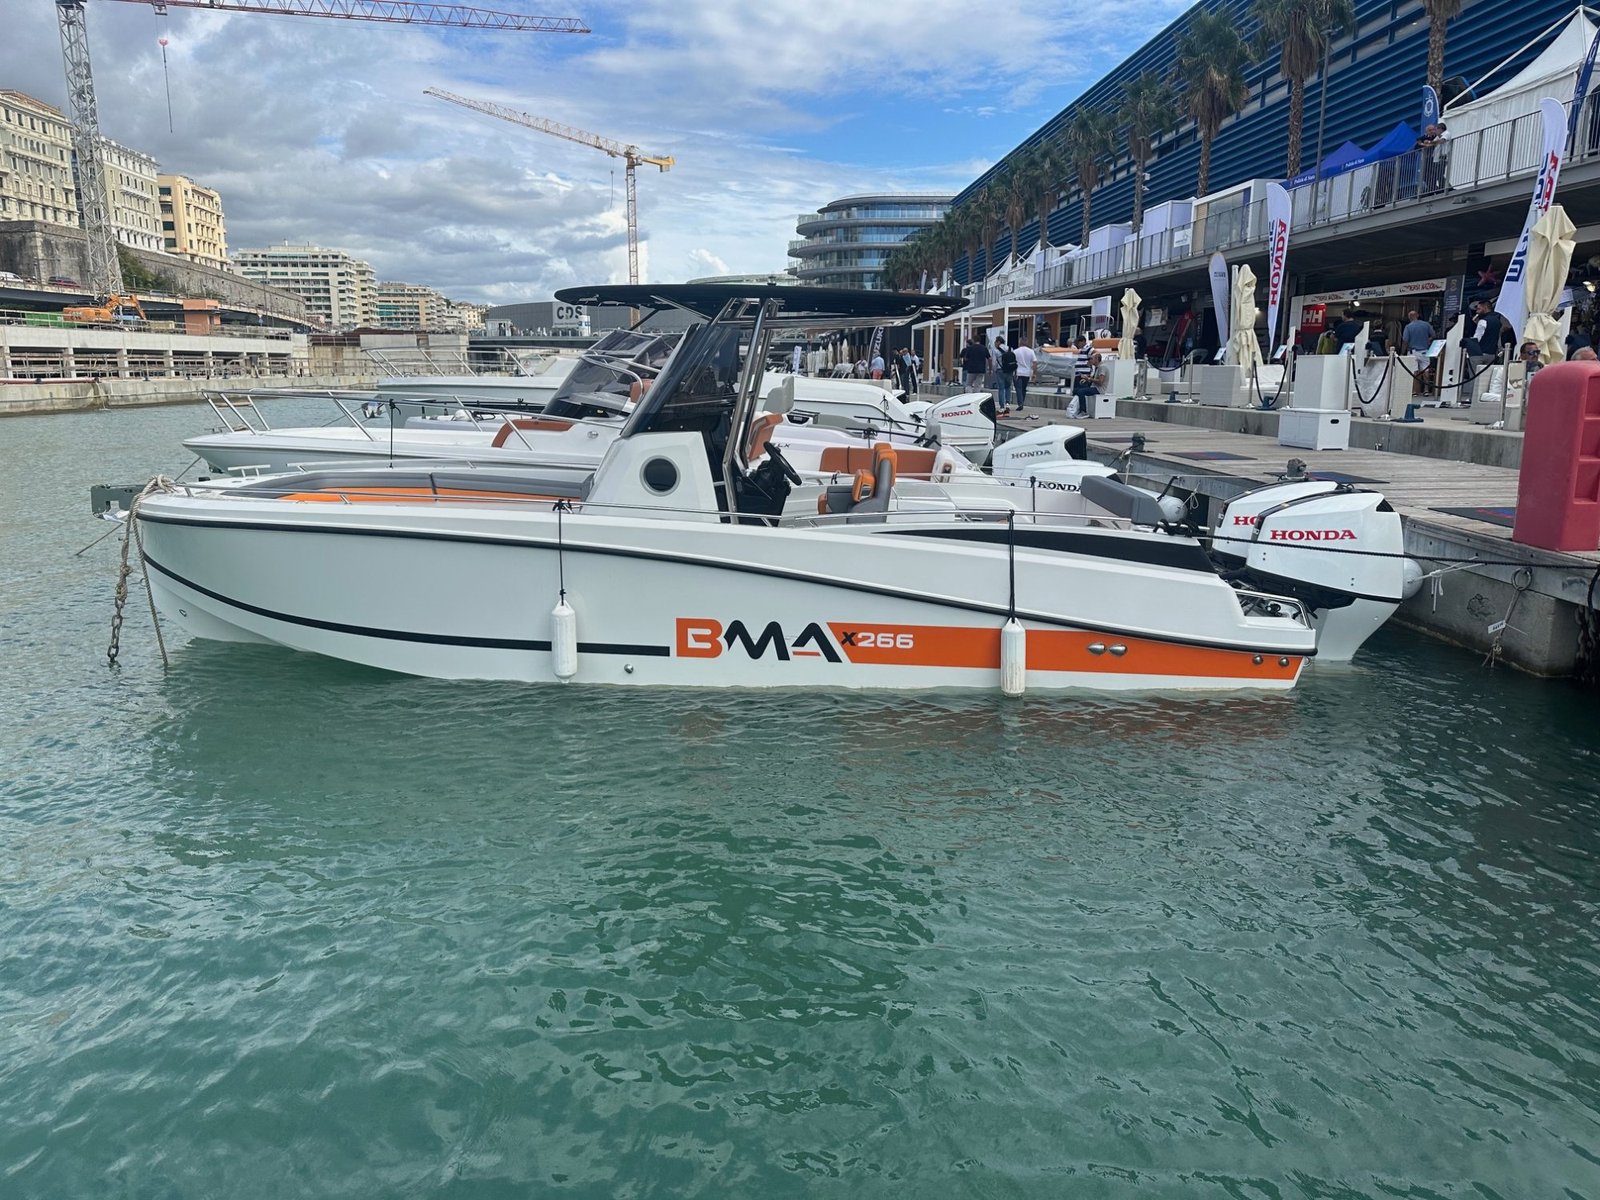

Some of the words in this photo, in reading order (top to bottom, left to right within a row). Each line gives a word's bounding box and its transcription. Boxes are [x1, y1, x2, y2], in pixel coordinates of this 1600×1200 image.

[557, 305, 583, 319] CDS
[1302, 309, 1323, 323] HH
[872, 326, 884, 358] UZUKI
[941, 409, 974, 418] HONDA
[1011, 448, 1052, 460] HONDA
[1270, 529, 1357, 541] HONDA
[676, 617, 843, 663] BMA
